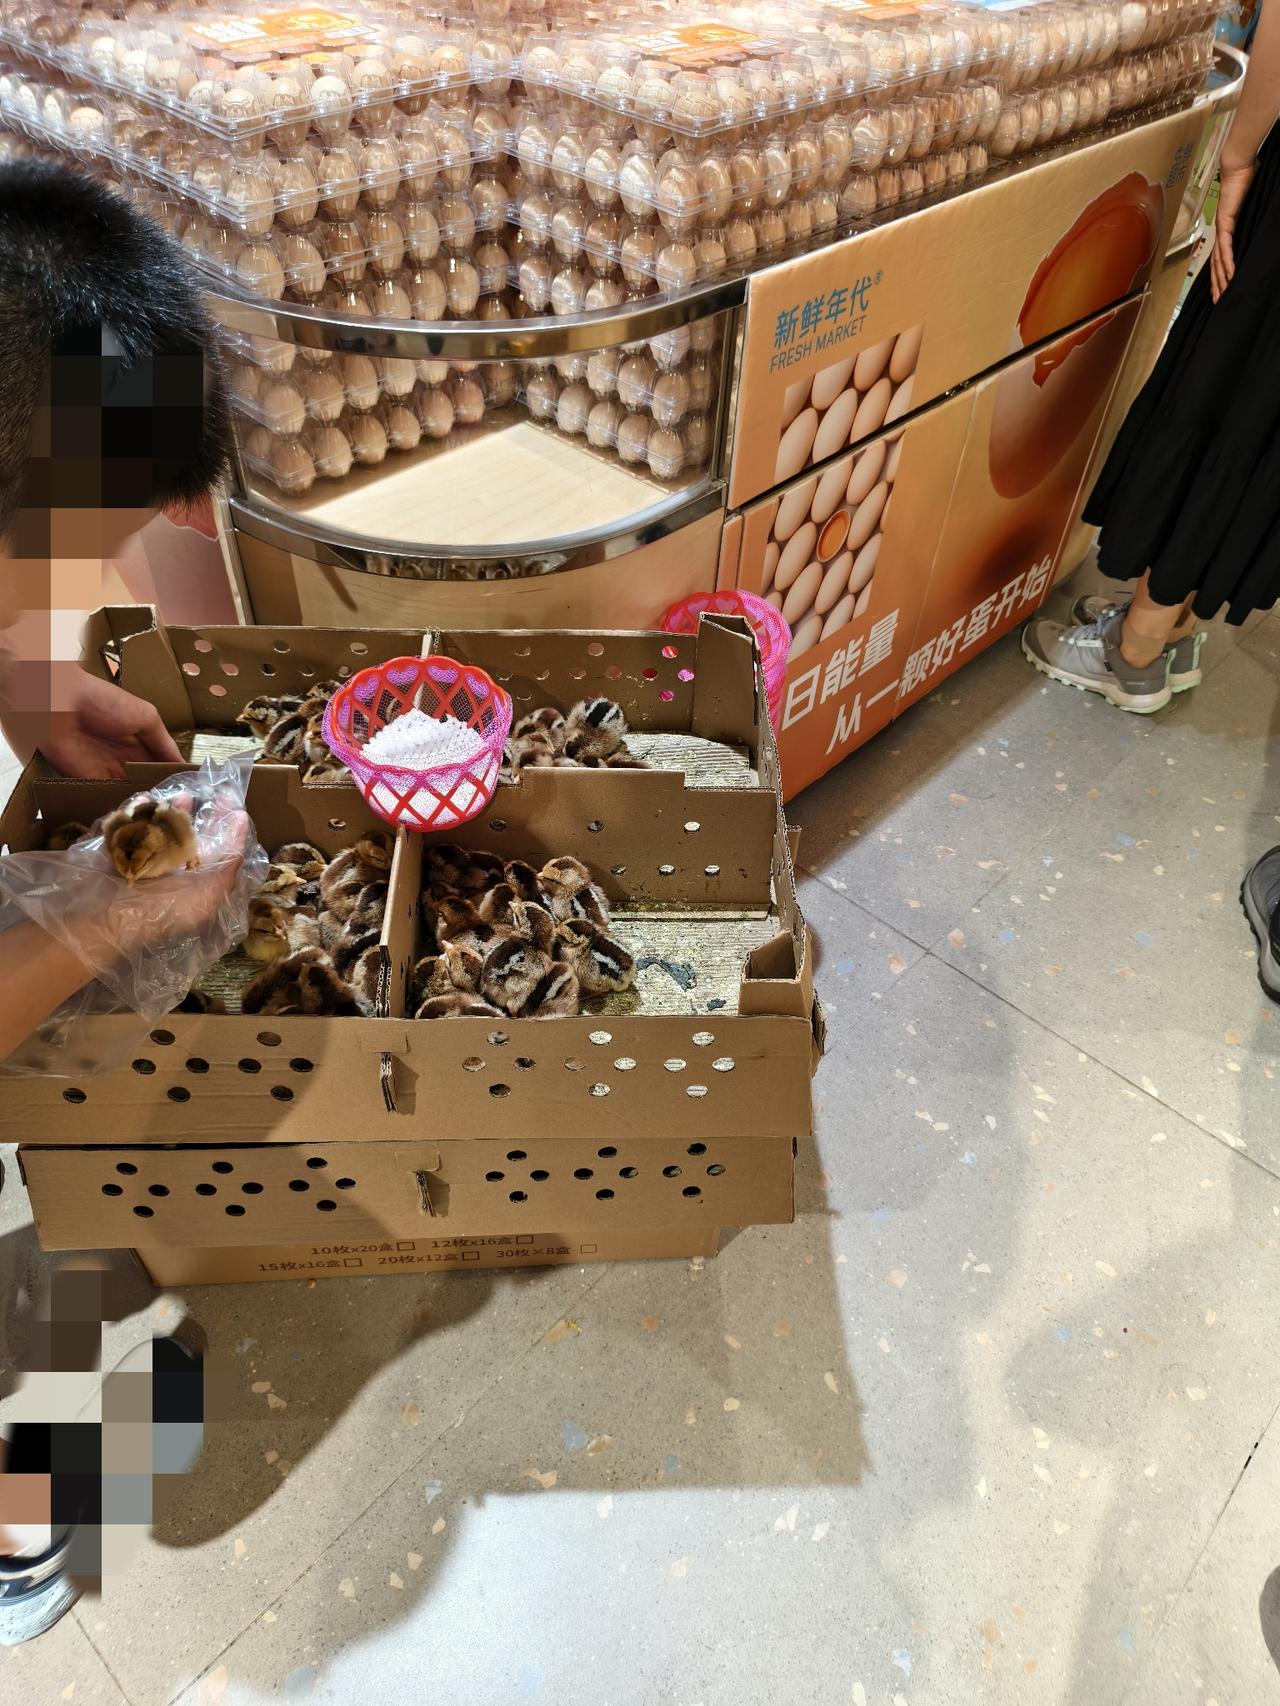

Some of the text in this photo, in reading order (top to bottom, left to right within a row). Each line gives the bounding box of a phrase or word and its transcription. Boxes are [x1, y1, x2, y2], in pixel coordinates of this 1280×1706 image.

[769, 315, 867, 375] FRESH MARKET
[773, 275, 872, 349] 新鲜年代
[824, 554, 1052, 756] 从一颗好蛋开始
